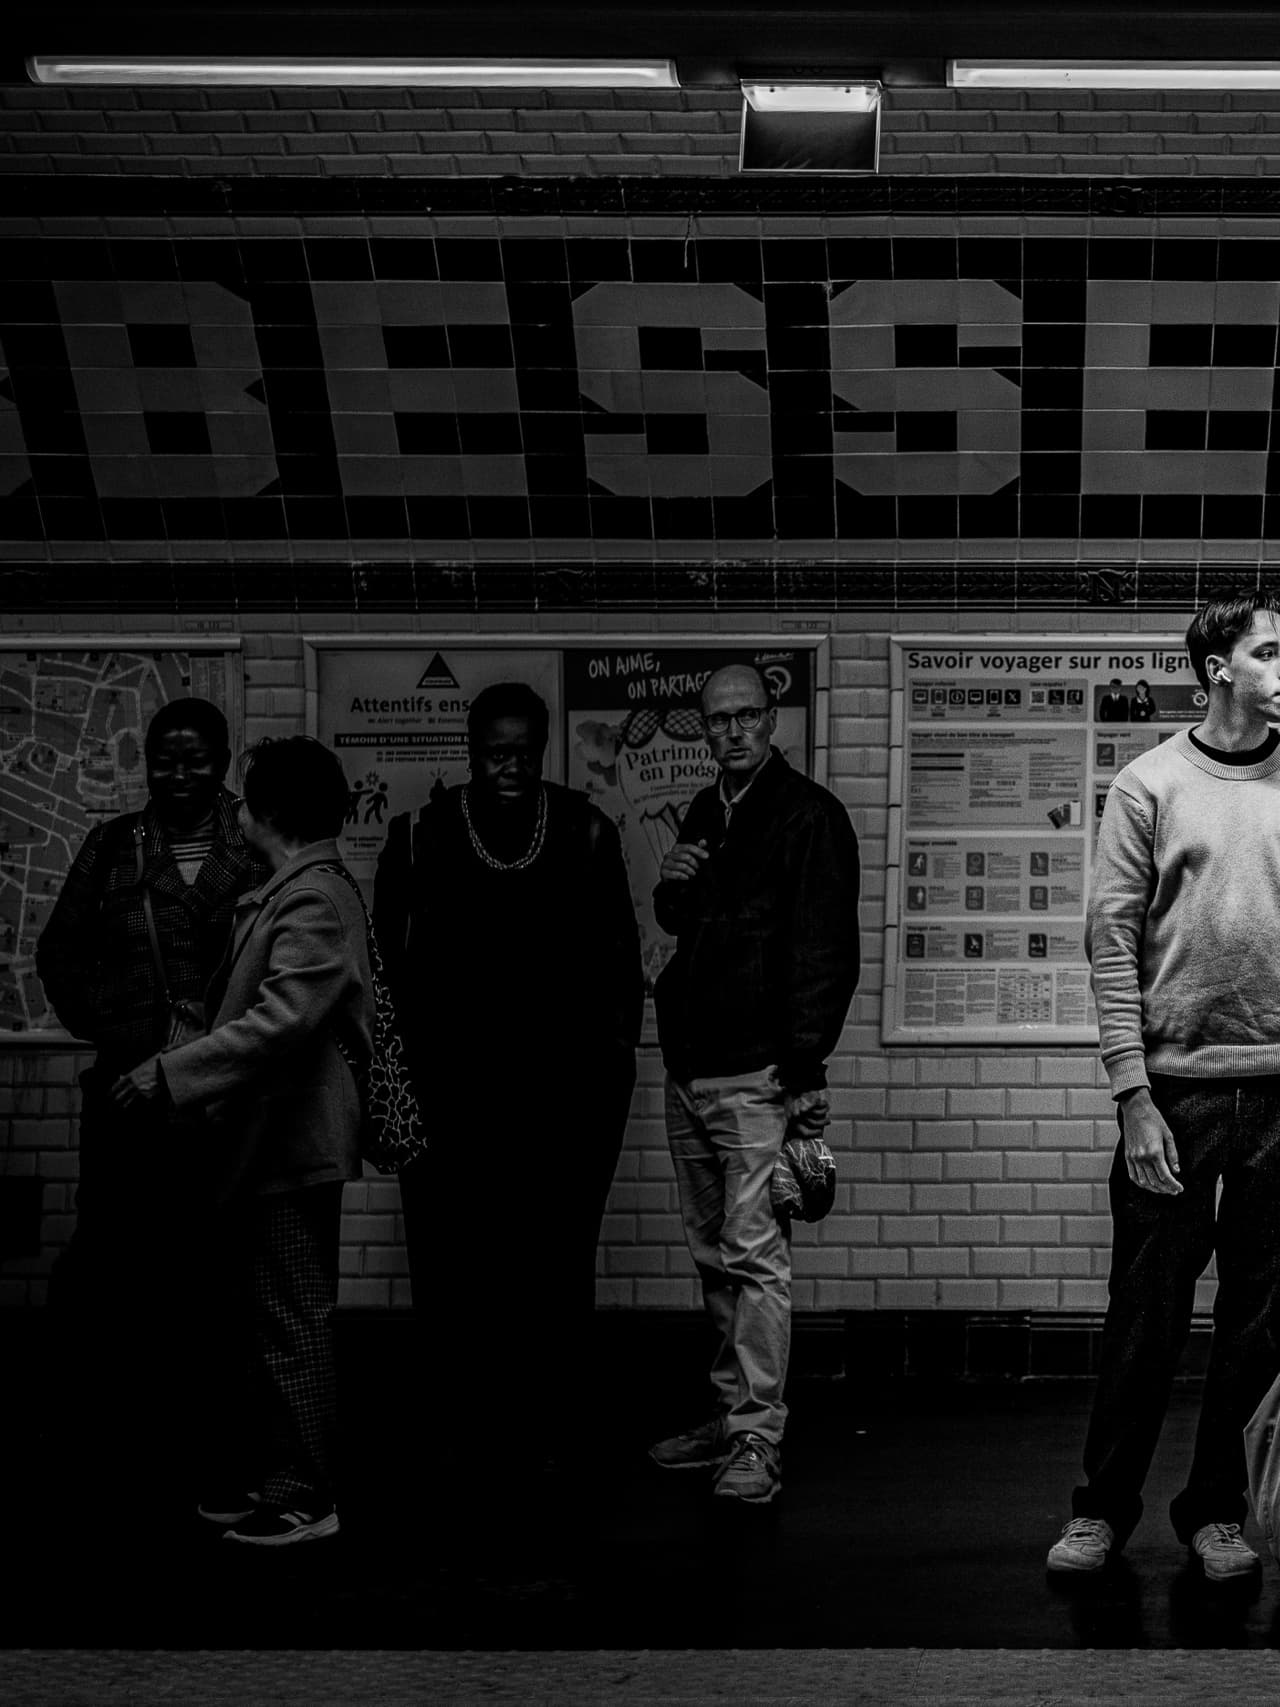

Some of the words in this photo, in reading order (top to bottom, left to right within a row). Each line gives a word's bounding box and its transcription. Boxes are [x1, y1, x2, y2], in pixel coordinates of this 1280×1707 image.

[588, 657, 611, 679] ON
[908, 652, 974, 669] Savoir
[979, 655, 1062, 673] voyager
[1068, 656, 1102, 669] sur
[1108, 656, 1145, 669] nos
[627, 679, 647, 700] ON
[350, 696, 433, 713] Attentifs
[340, 735, 377, 745] TÉMOIN
[411, 735, 462, 744] SITUATION
[639, 767, 664, 783] en
